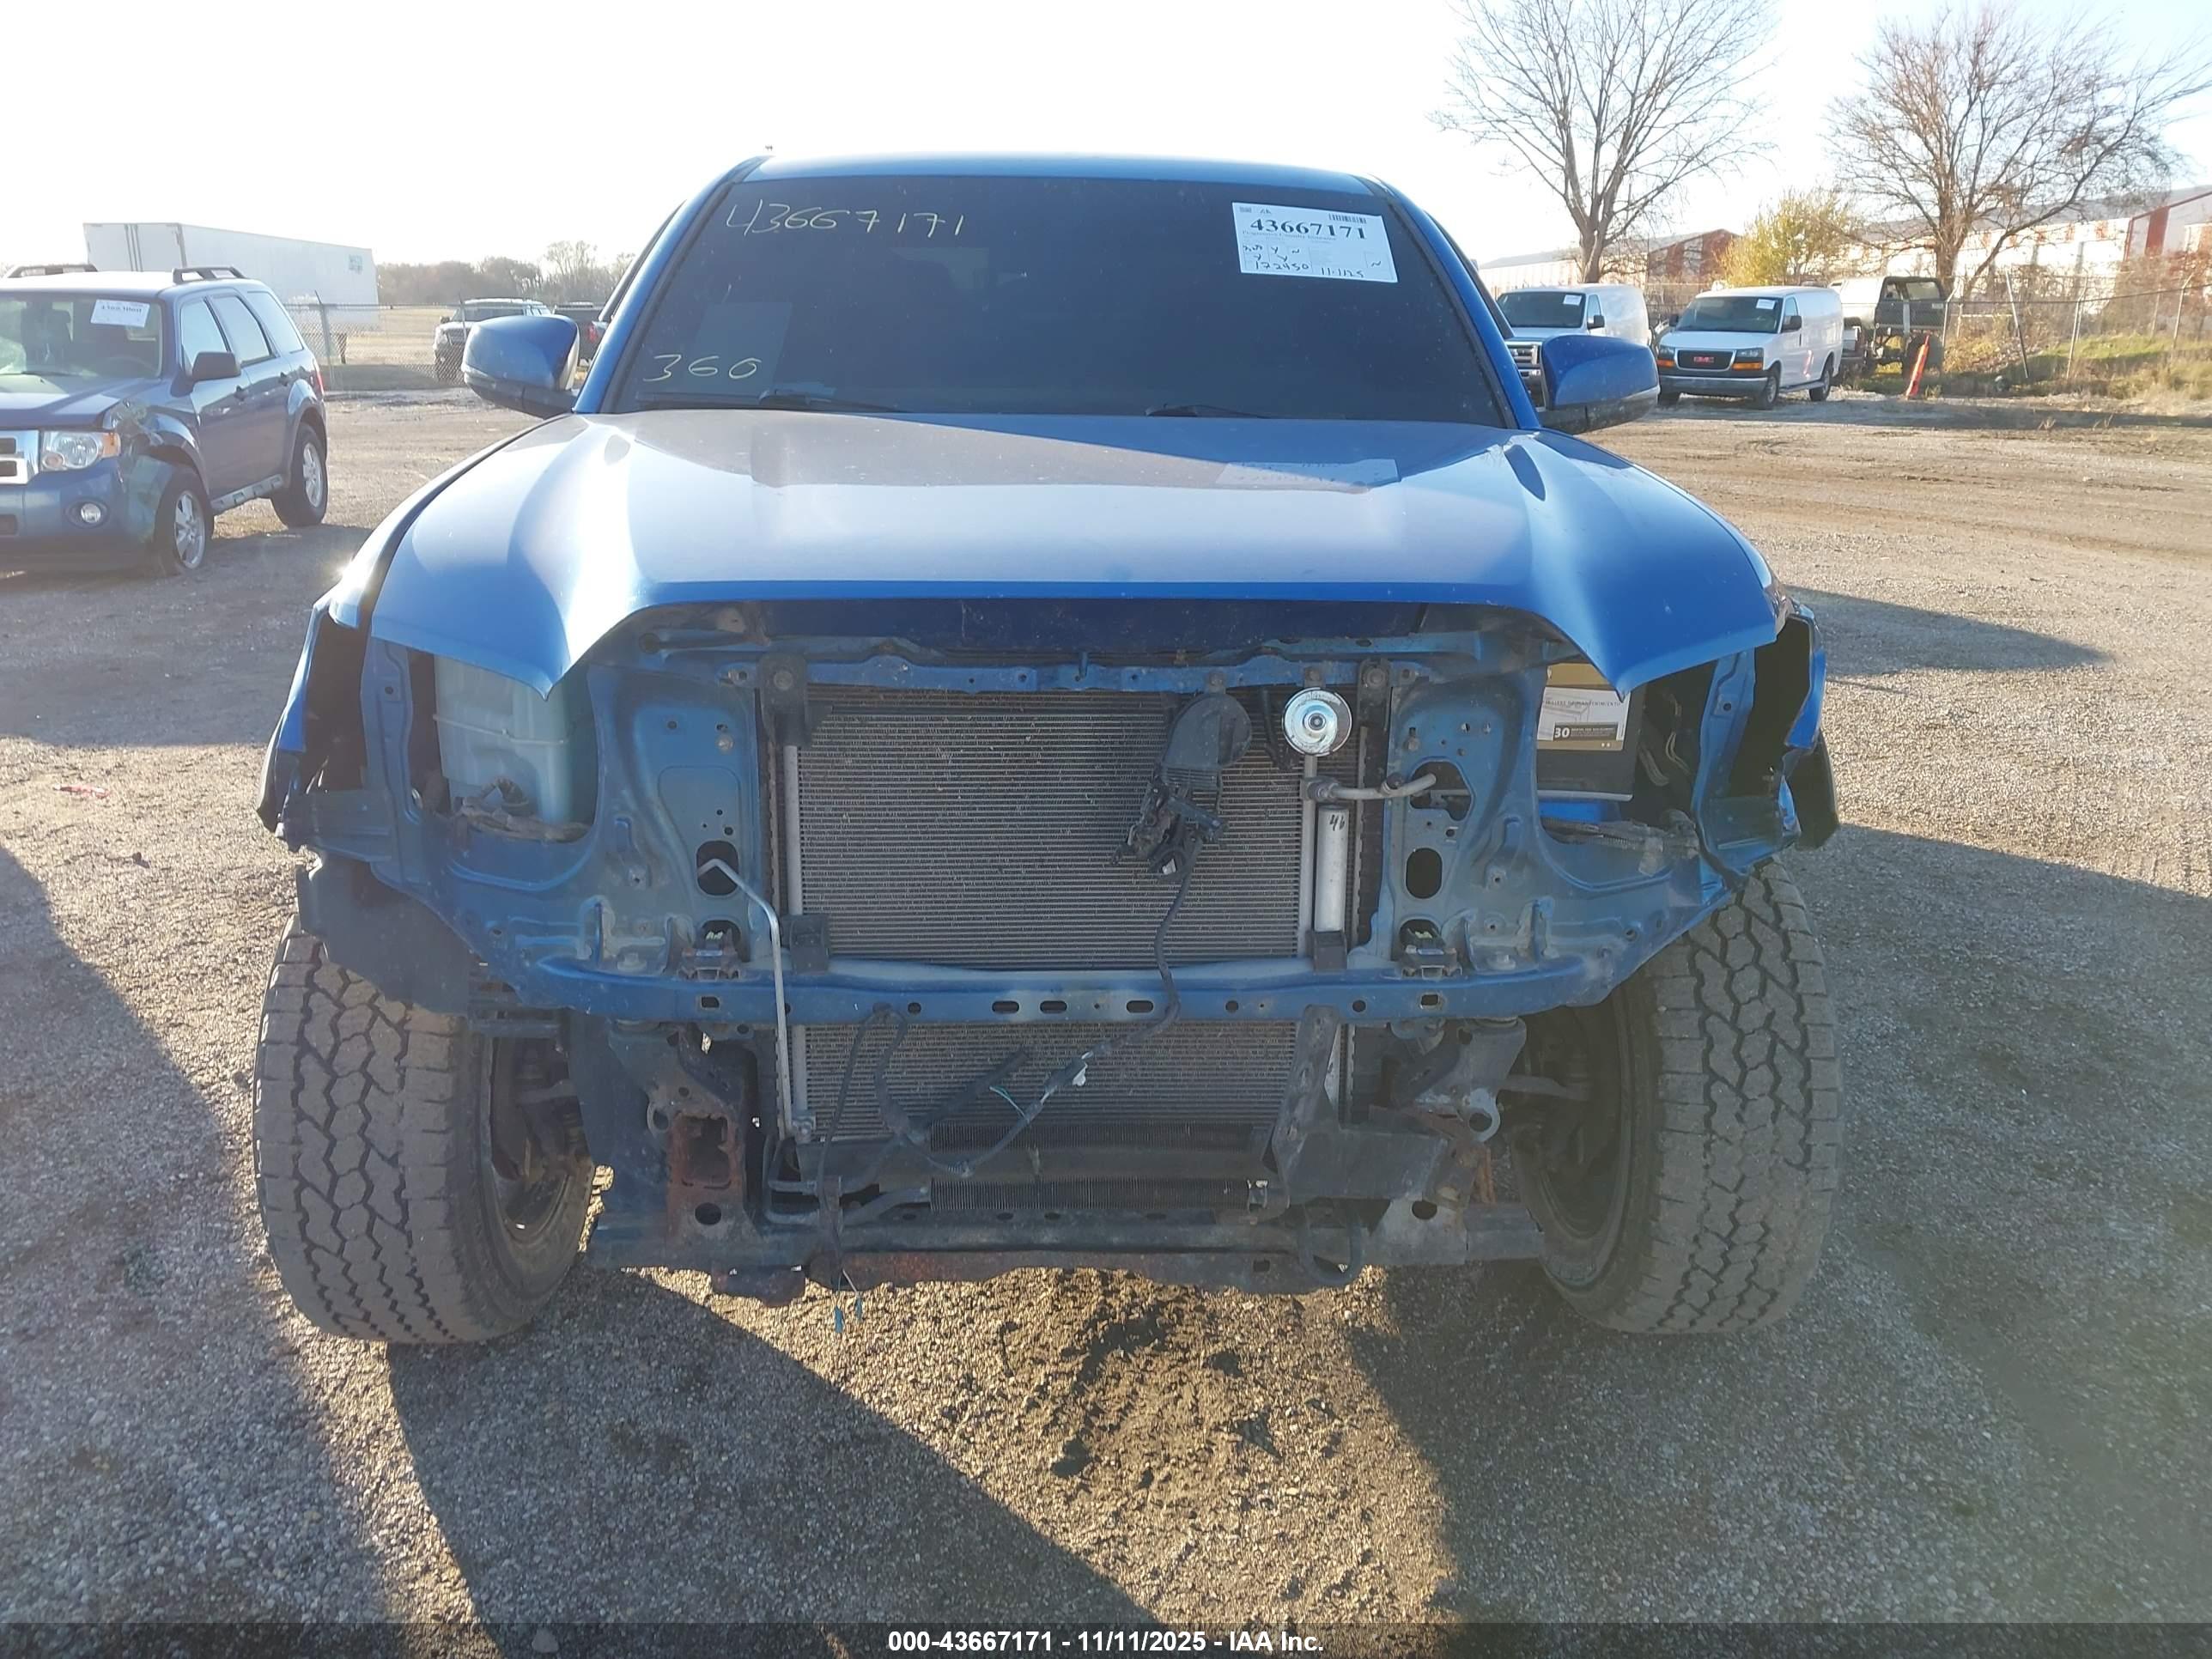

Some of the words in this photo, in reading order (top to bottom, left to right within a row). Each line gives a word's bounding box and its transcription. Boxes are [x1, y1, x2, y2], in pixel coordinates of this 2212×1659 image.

[726, 198, 964, 238] 43667171
[1250, 218, 1367, 240] 43667171
[643, 354, 762, 381] 360
[1554, 726, 1571, 738] 30
